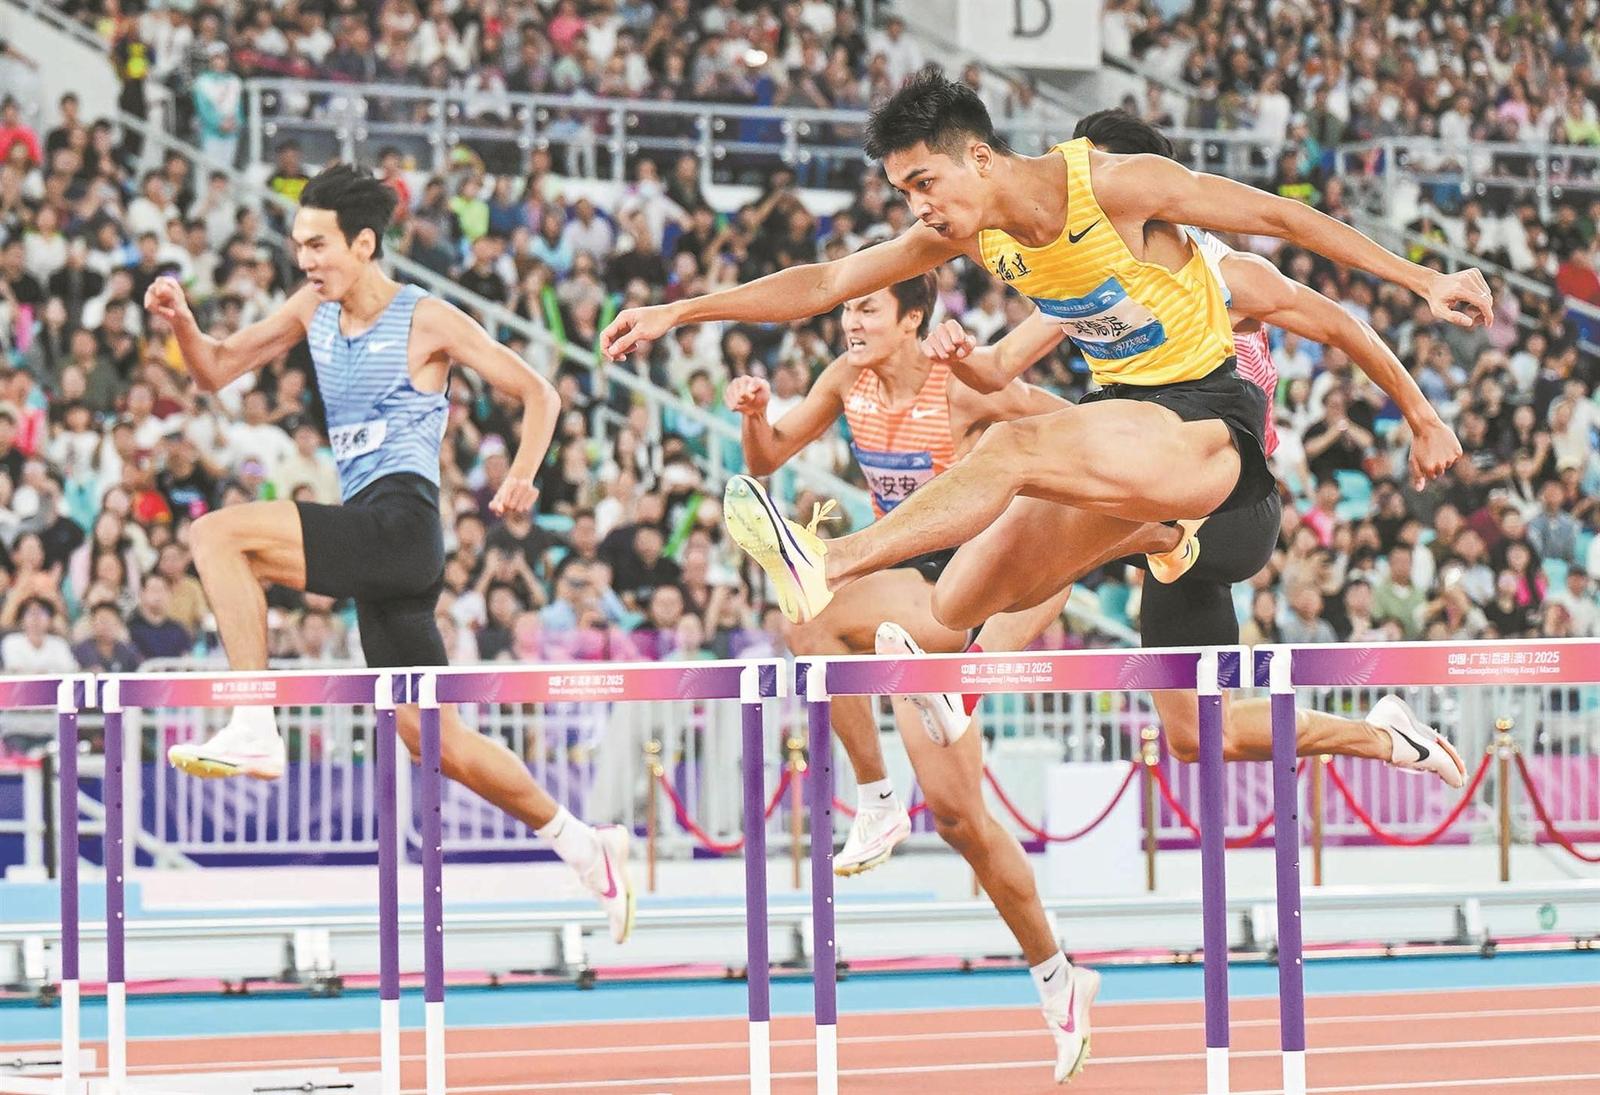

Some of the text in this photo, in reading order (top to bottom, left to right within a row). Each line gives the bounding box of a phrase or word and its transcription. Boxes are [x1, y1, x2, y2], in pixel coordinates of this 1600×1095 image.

[1013, 0, 1052, 38] D
[1534, 651, 1560, 663] 2025
[1031, 662, 1053, 674] 2025
